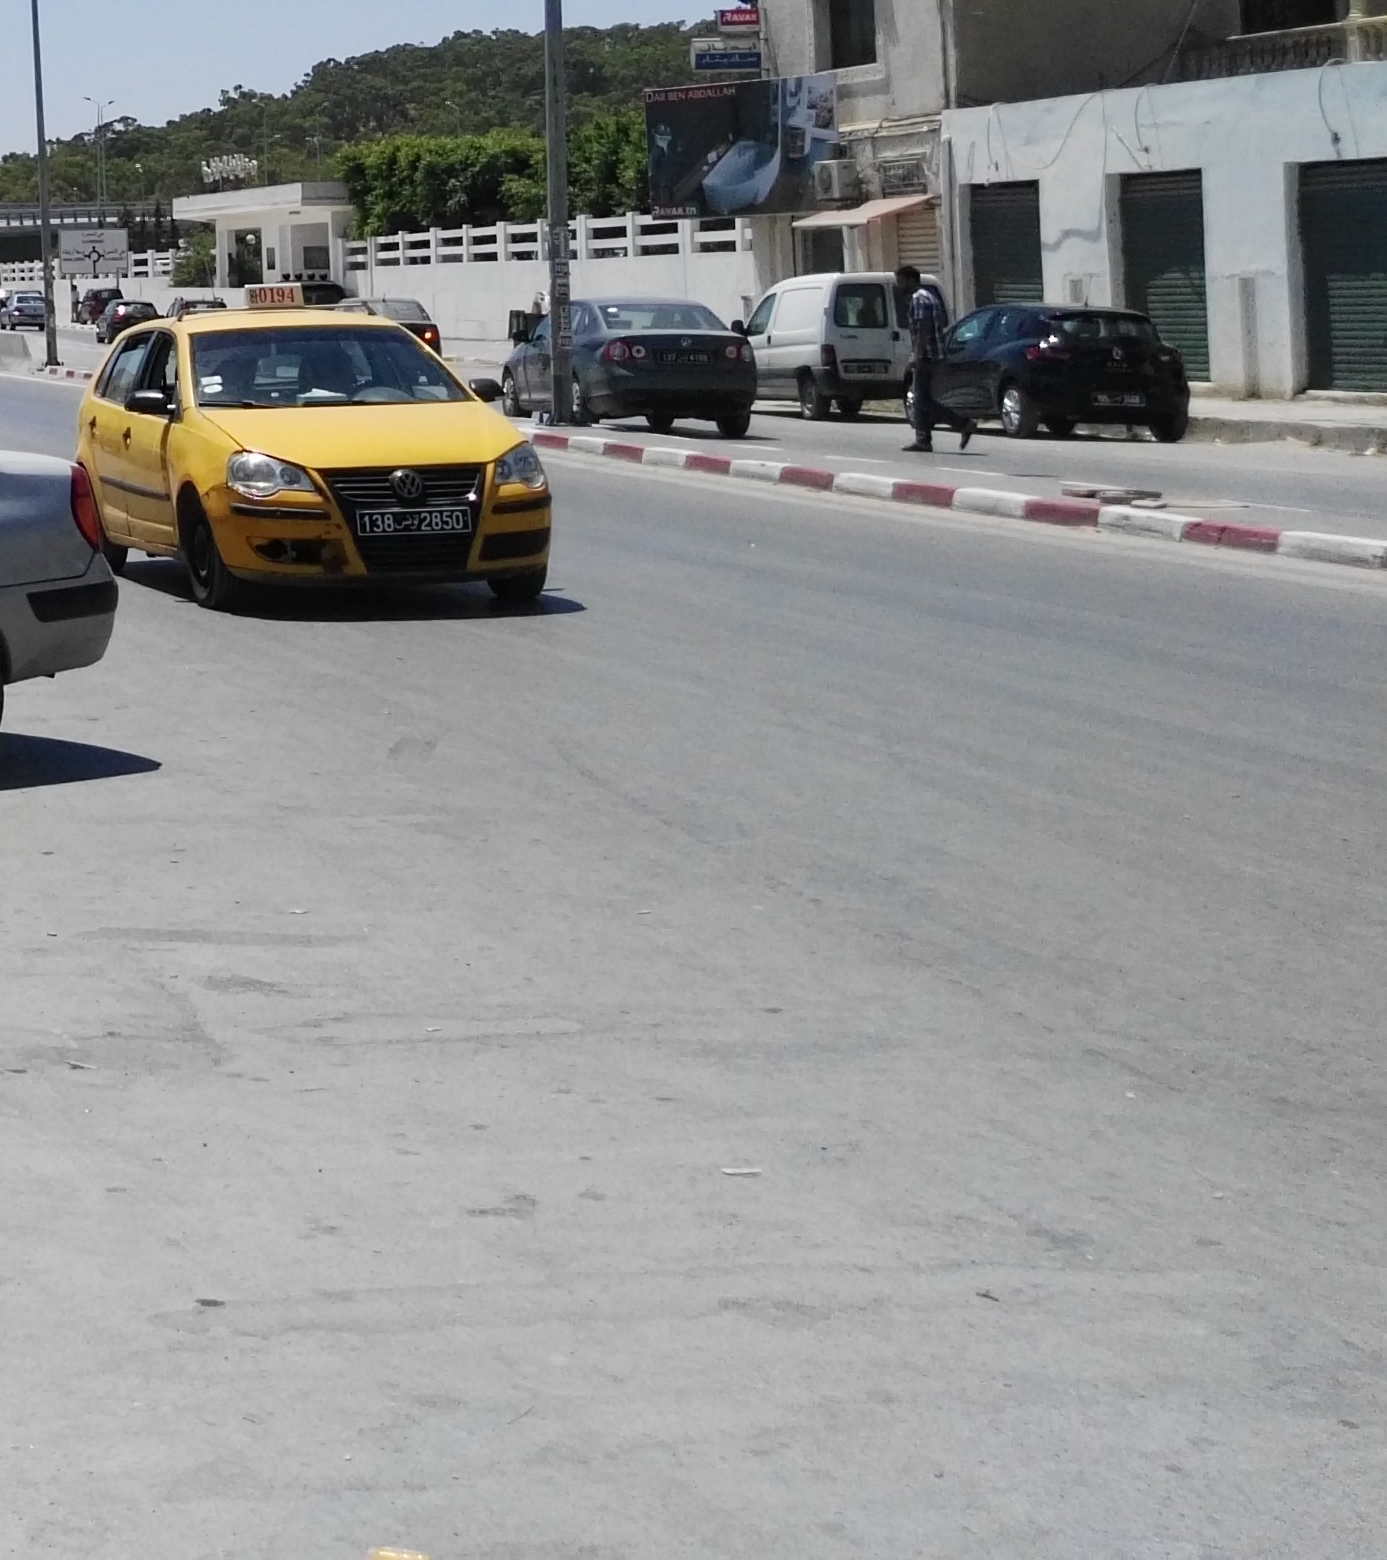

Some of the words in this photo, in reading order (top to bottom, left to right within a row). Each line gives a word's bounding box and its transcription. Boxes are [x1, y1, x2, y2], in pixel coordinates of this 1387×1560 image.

[668, 90, 686, 101] BEN
[688, 85, 736, 99] ABDALLAH
[261, 287, 295, 304] 0194
[363, 514, 394, 532] 138
[395, 514, 419, 529] تونس
[421, 511, 463, 530] 2850
